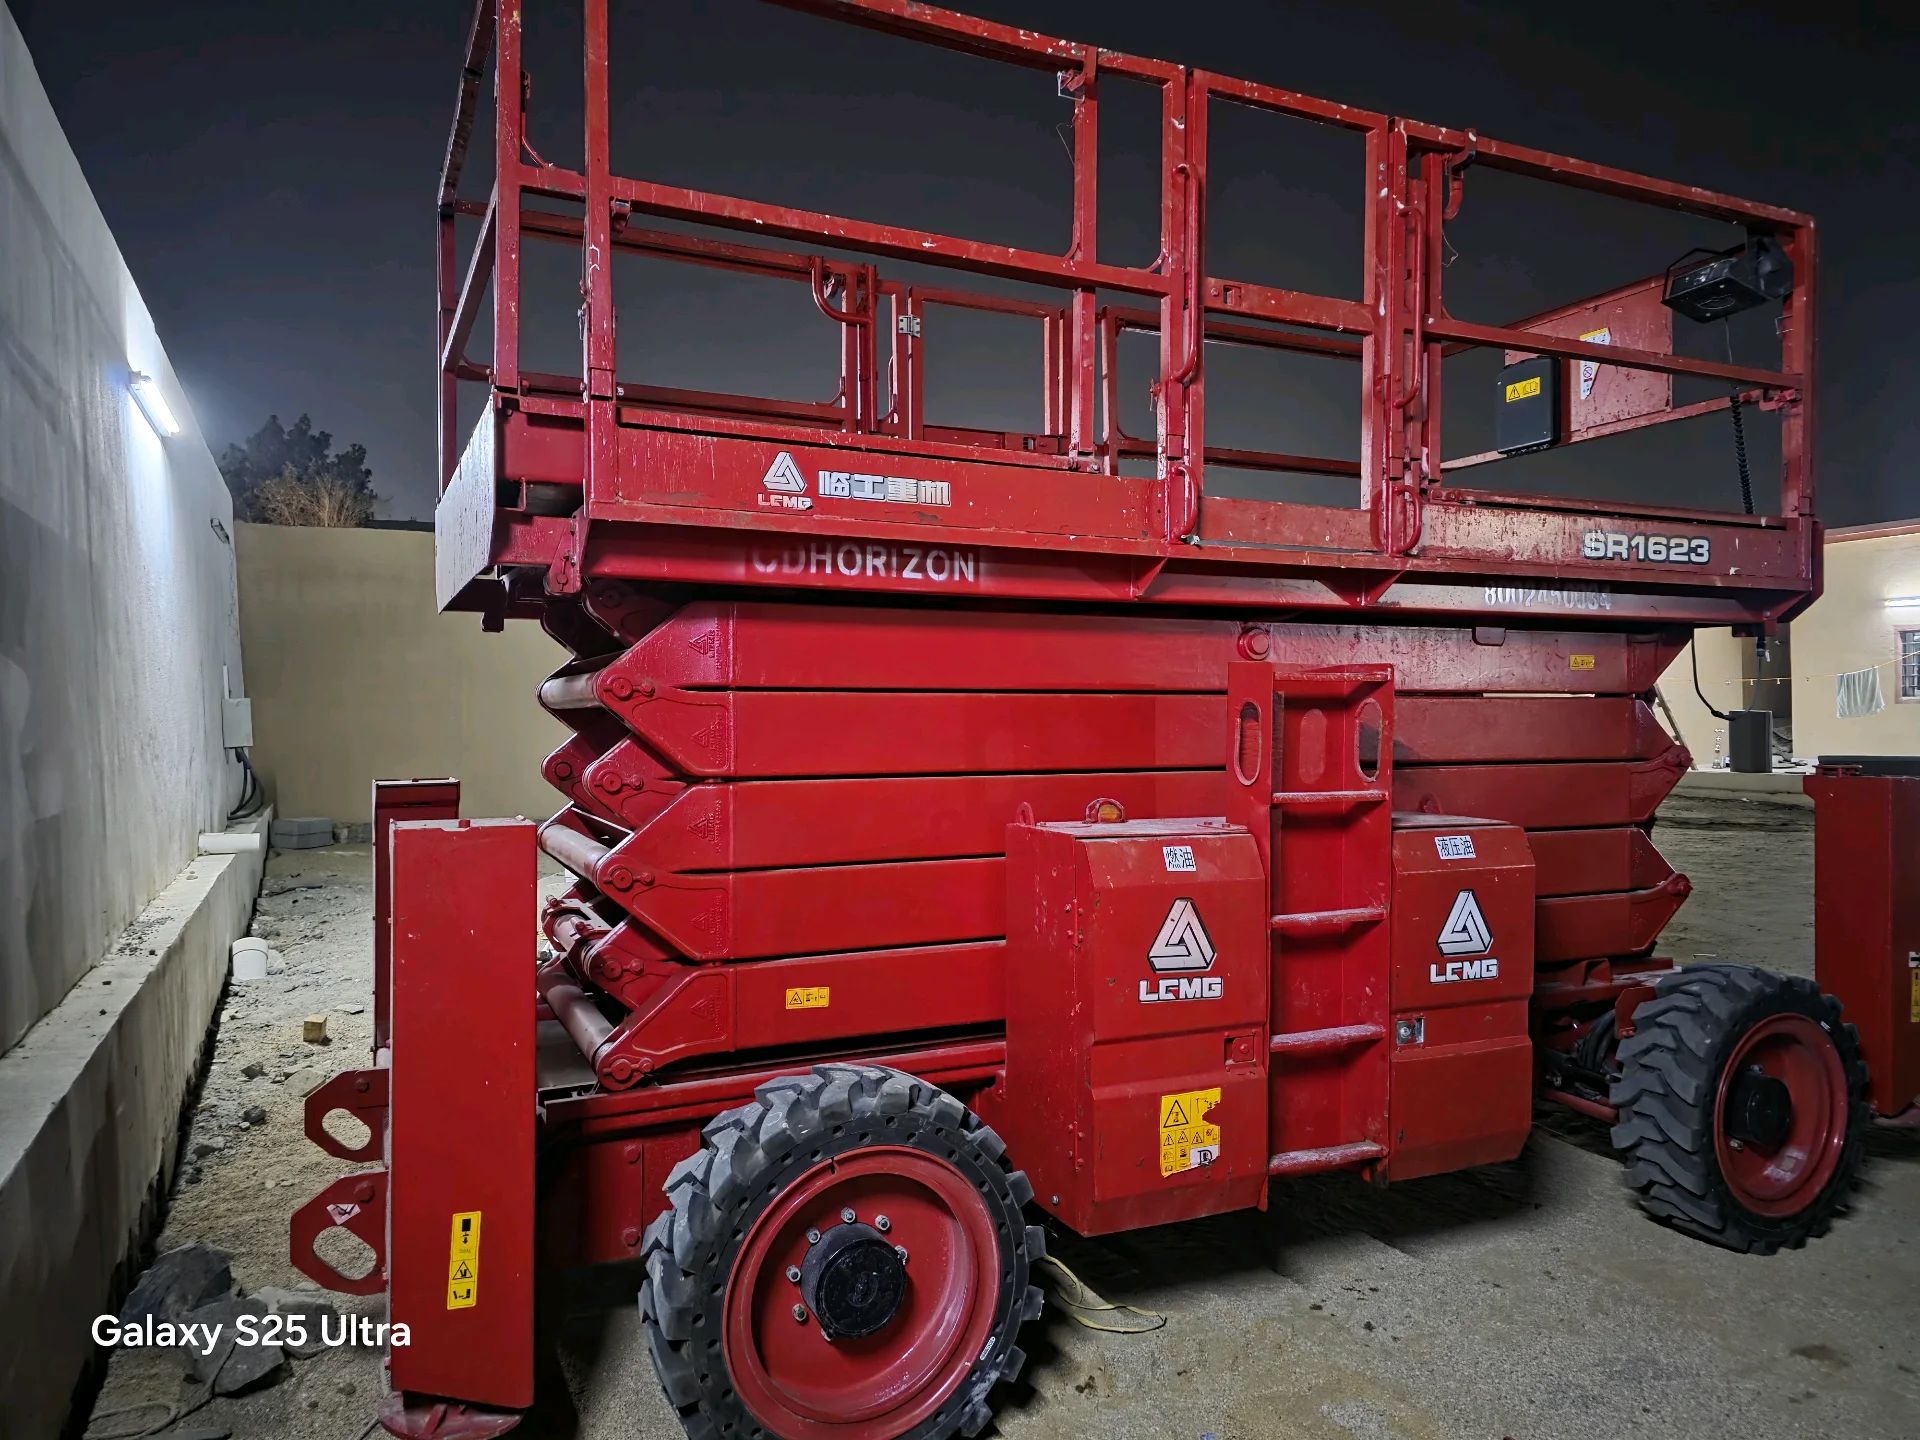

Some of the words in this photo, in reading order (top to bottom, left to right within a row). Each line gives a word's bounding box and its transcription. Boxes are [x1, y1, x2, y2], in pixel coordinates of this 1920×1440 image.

[818, 470, 950, 506] 临工重机
[757, 493, 813, 510] LCMG
[1583, 530, 1710, 563] SR1623
[1428, 958, 1499, 983] LCMG
[1138, 977, 1224, 1003] LCMG
